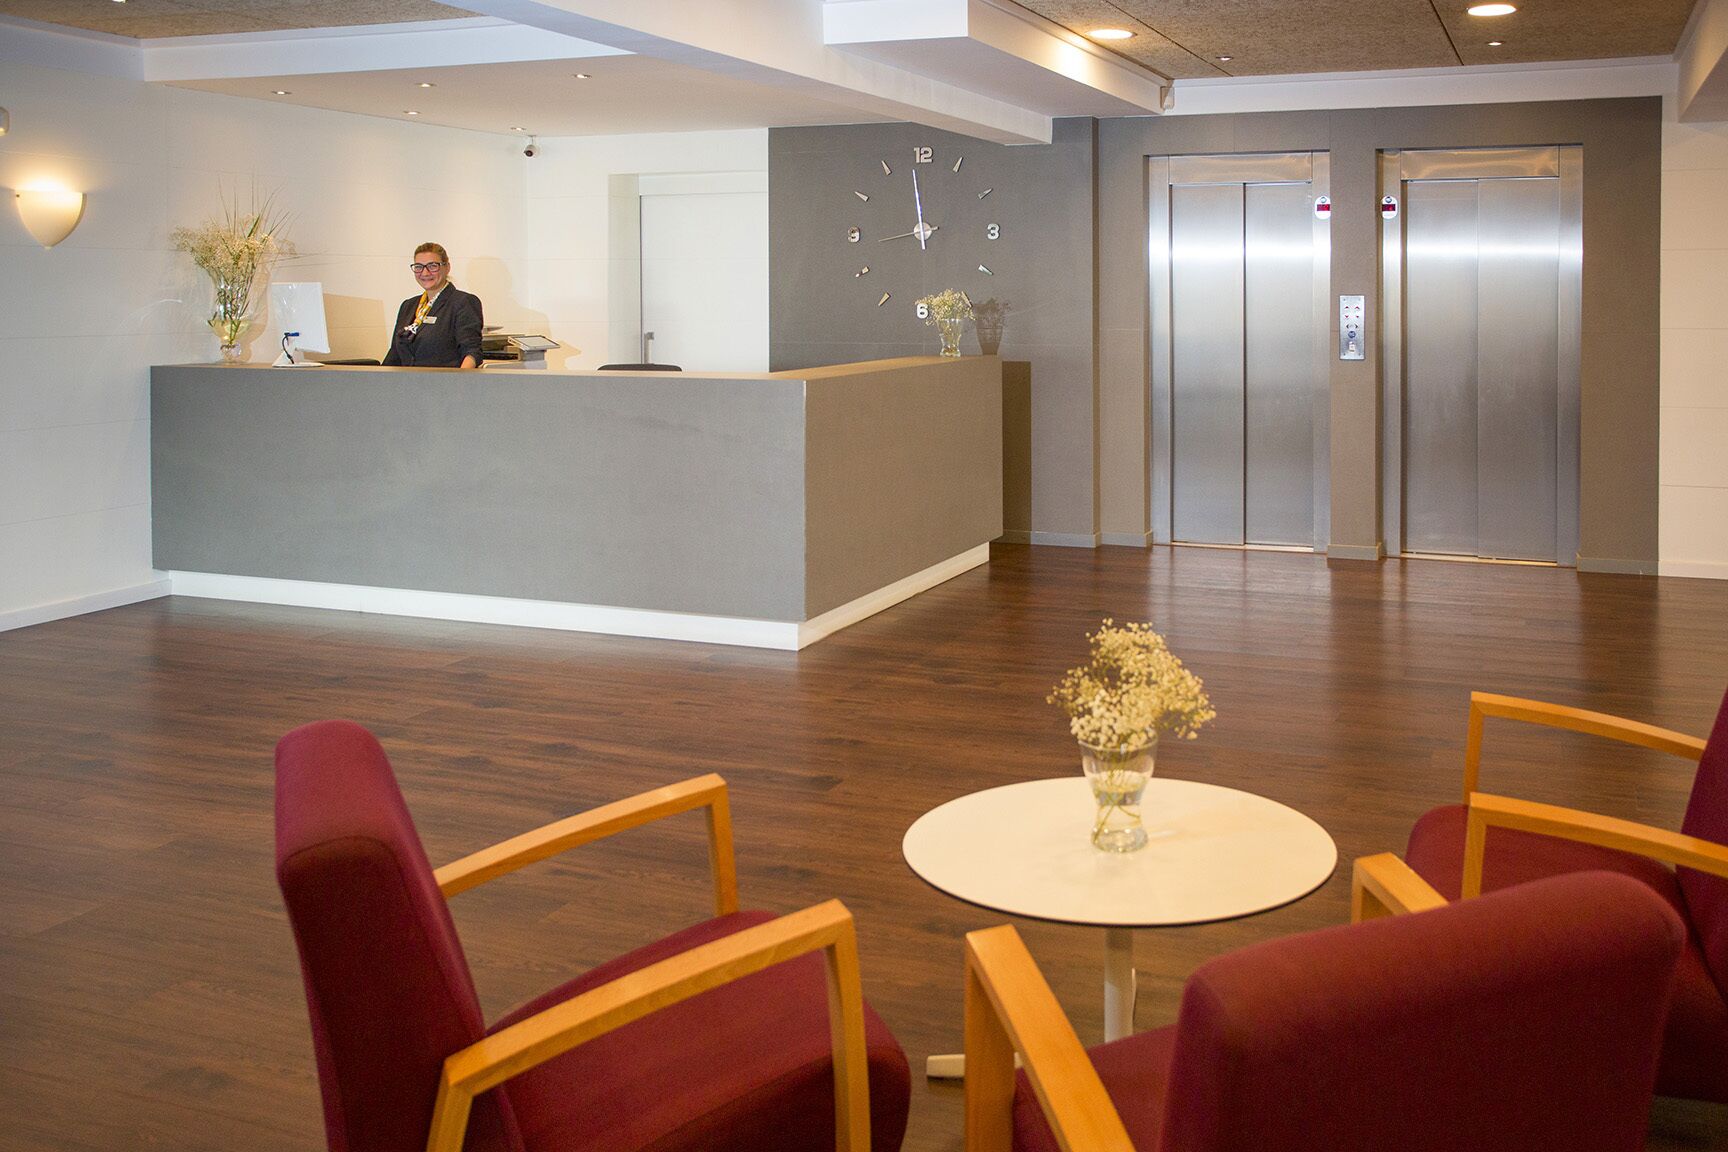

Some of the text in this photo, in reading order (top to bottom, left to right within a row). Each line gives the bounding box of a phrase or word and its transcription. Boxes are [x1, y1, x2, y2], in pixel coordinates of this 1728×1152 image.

[913, 147, 933, 163] 12
[847, 226, 861, 243] 9
[987, 223, 1000, 240] 3
[916, 303, 929, 319] 6
